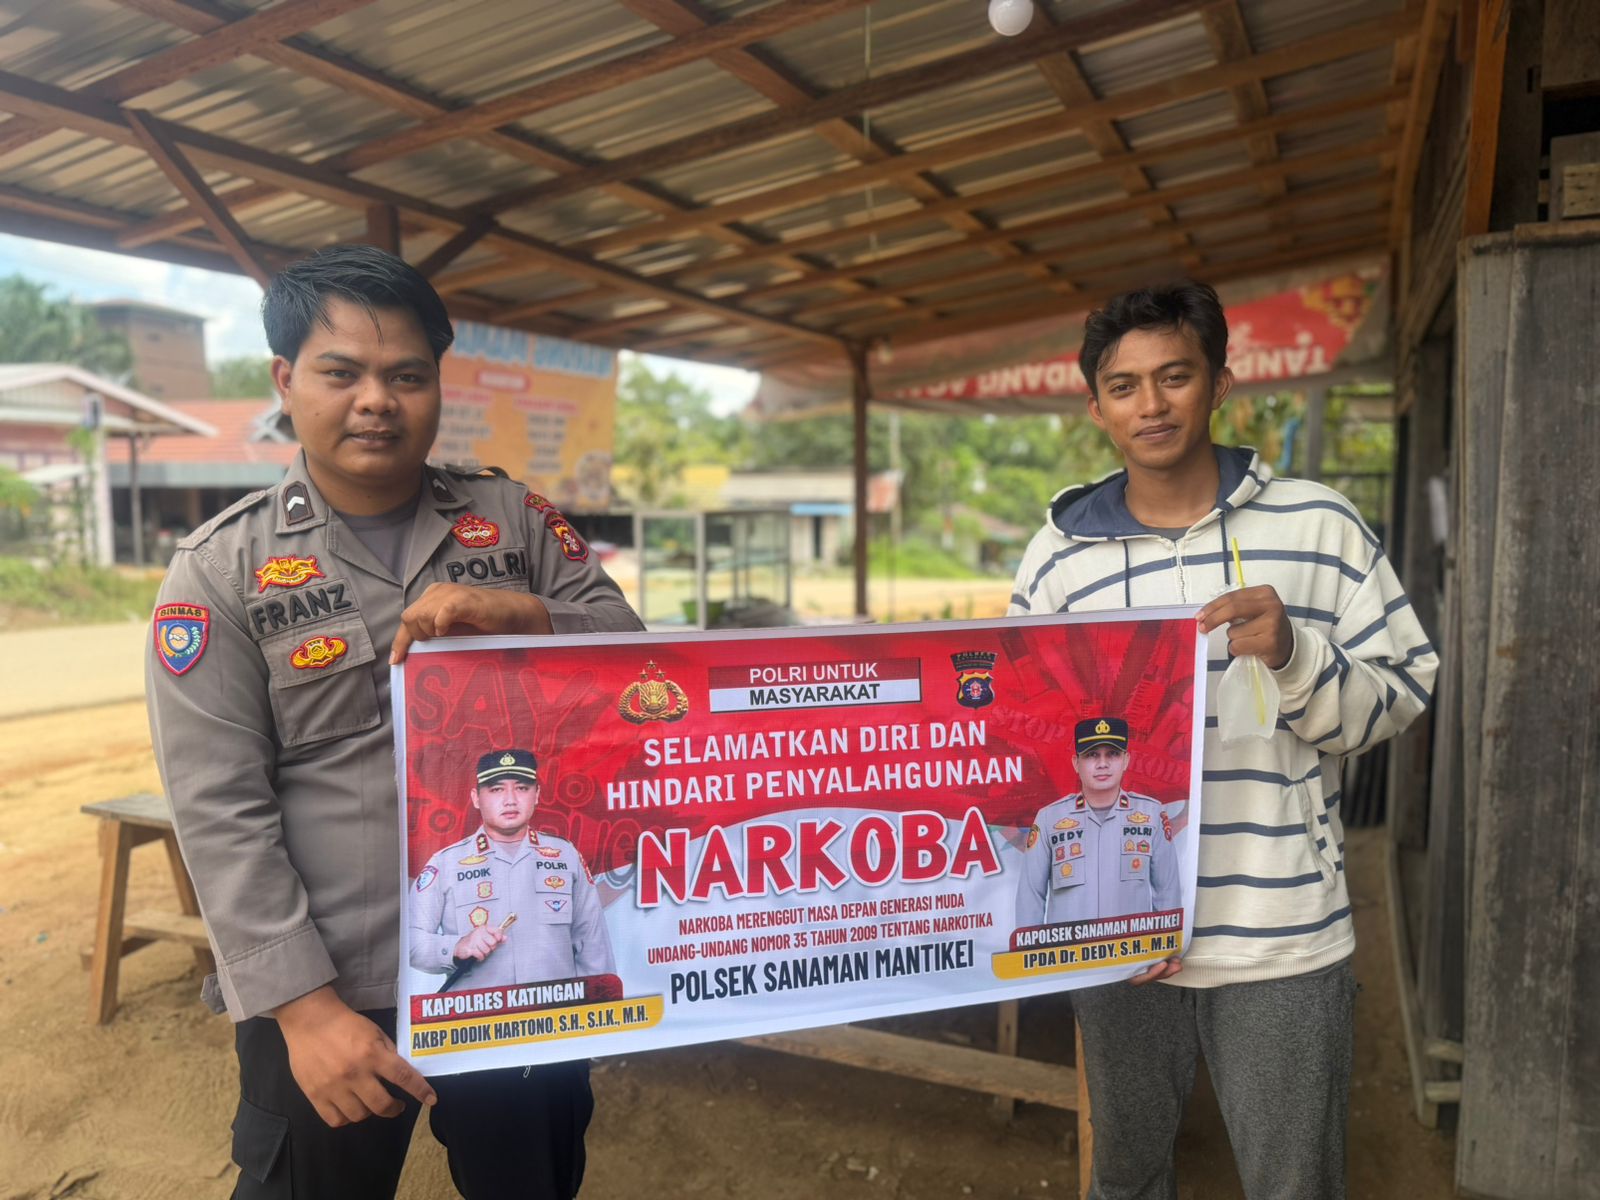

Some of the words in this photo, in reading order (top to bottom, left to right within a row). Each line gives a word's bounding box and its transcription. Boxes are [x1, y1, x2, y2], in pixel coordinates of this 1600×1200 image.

[446, 550, 527, 583] POLRI
[159, 606, 203, 617] BINMAS
[250, 583, 352, 635] FRANZ
[750, 666, 807, 684] POLRI
[813, 663, 878, 681] UNTUK
[749, 683, 881, 706] MASYARAKAT
[644, 728, 848, 767] SELAMATKAN
[860, 723, 921, 752] DIRI
[930, 720, 986, 749] DAN
[607, 773, 736, 810] HINDARI
[746, 756, 1023, 800] PENYALAHGUNAAN
[1051, 829, 1084, 845] DEDY
[1123, 826, 1152, 836] POLRI
[457, 867, 491, 882] DODIK
[536, 861, 568, 870] POLRI
[637, 807, 1001, 908] NARKOBA
[679, 914, 734, 936] NARKOBA
[736, 907, 805, 929] MERENGGUT
[808, 905, 838, 923] MASA
[841, 901, 877, 919] DEPAN
[880, 895, 932, 916] GENERASI
[935, 893, 965, 910] MUDA
[1016, 926, 1073, 947] KAPOLSEK
[1074, 919, 1128, 939] SANAMAN
[1130, 912, 1180, 932] MANTIKEI
[647, 938, 748, 965] UNDANG-UNDANG
[751, 933, 791, 953] NOMOR
[793, 932, 808, 948] 35
[810, 930, 848, 947] TAHUN
[850, 925, 878, 943] 2009
[880, 919, 930, 939] TENTANG
[933, 912, 993, 933] NARKOTIKA
[1023, 952, 1057, 969] IPDA
[1060, 950, 1078, 964] Dr.
[1081, 944, 1118, 962] DEDY,
[1120, 940, 1148, 956] S.H.,
[1151, 935, 1178, 951] M.H.
[671, 964, 758, 1004] POLSEK
[764, 951, 869, 993] SANAMAN
[875, 939, 974, 979] MANTIKEI
[421, 989, 504, 1018] KAPOLRES
[506, 981, 585, 1008] KATINGAN
[412, 1030, 447, 1050] AKBP
[450, 1023, 491, 1045] DODIK
[494, 1017, 557, 1040] HARTONO,
[559, 1013, 585, 1032] S.H.,
[587, 1010, 620, 1029] S.I.K.,
[623, 1005, 648, 1024] M.H.
